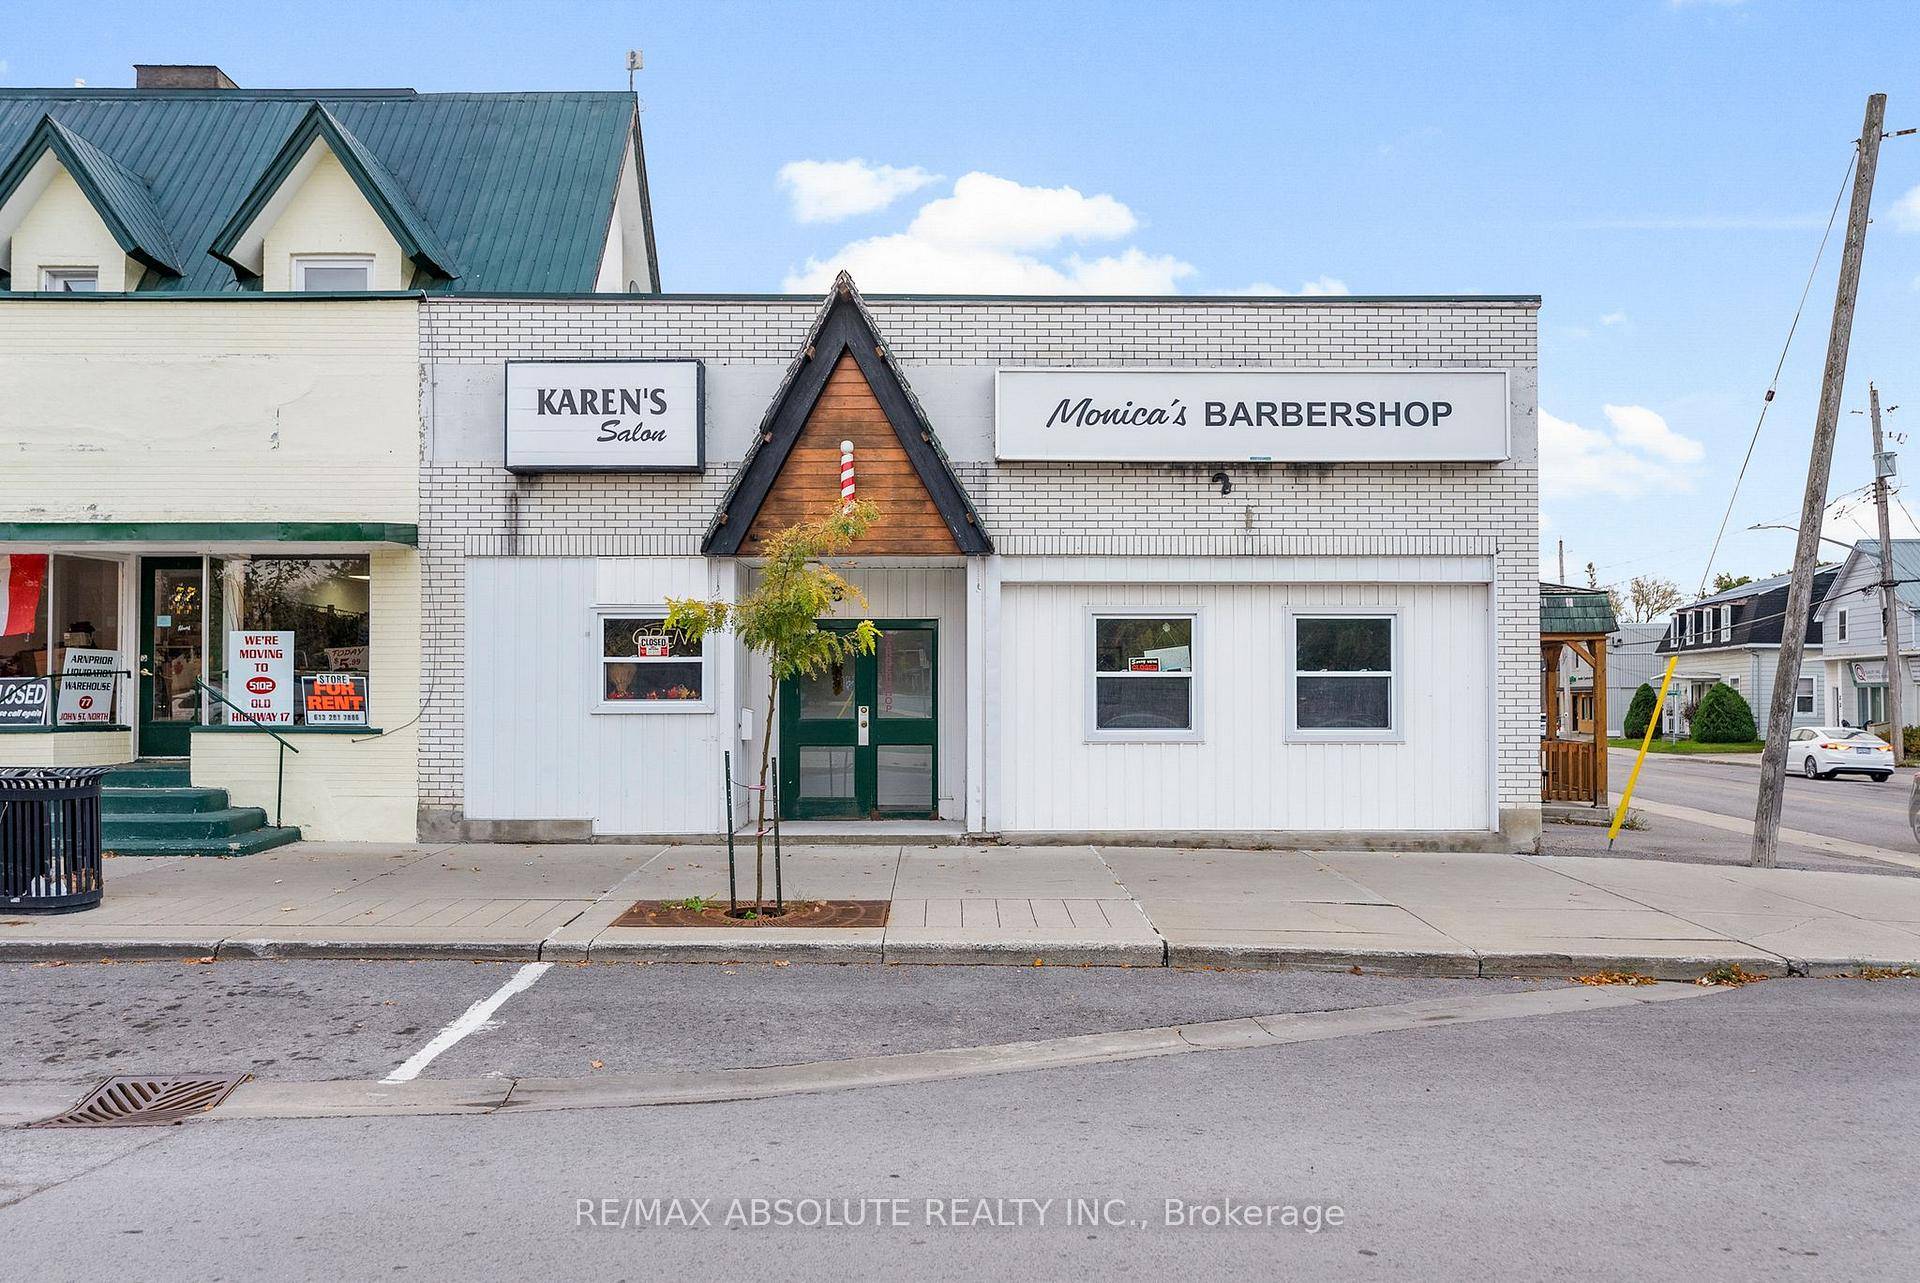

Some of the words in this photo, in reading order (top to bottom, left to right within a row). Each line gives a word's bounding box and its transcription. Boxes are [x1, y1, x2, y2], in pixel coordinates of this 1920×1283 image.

[537, 388, 667, 415] KAREN'S
[1046, 398, 1187, 428] Monica's
[1204, 401, 1453, 427] BARBERSHOP
[597, 419, 667, 442] Salon
[244, 635, 279, 646] WE'RE
[641, 638, 666, 646] CLOSED
[239, 649, 283, 659] MOVING
[331, 647, 364, 657] TODAY
[71, 654, 114, 665] ARNPRIOR
[254, 662, 269, 673] TO
[319, 675, 347, 684] STORE
[65, 681, 111, 691] WAREHOUSE
[249, 681, 273, 691] 5102
[313, 681, 355, 695] FOR
[81, 698, 92, 707] 77
[251, 699, 271, 709] OLD
[308, 696, 363, 710] RENT
[59, 713, 77, 721] JOHN
[88, 713, 109, 721] NORTH
[231, 712, 277, 722] HIGHWAY
[280, 712, 290, 722] 17
